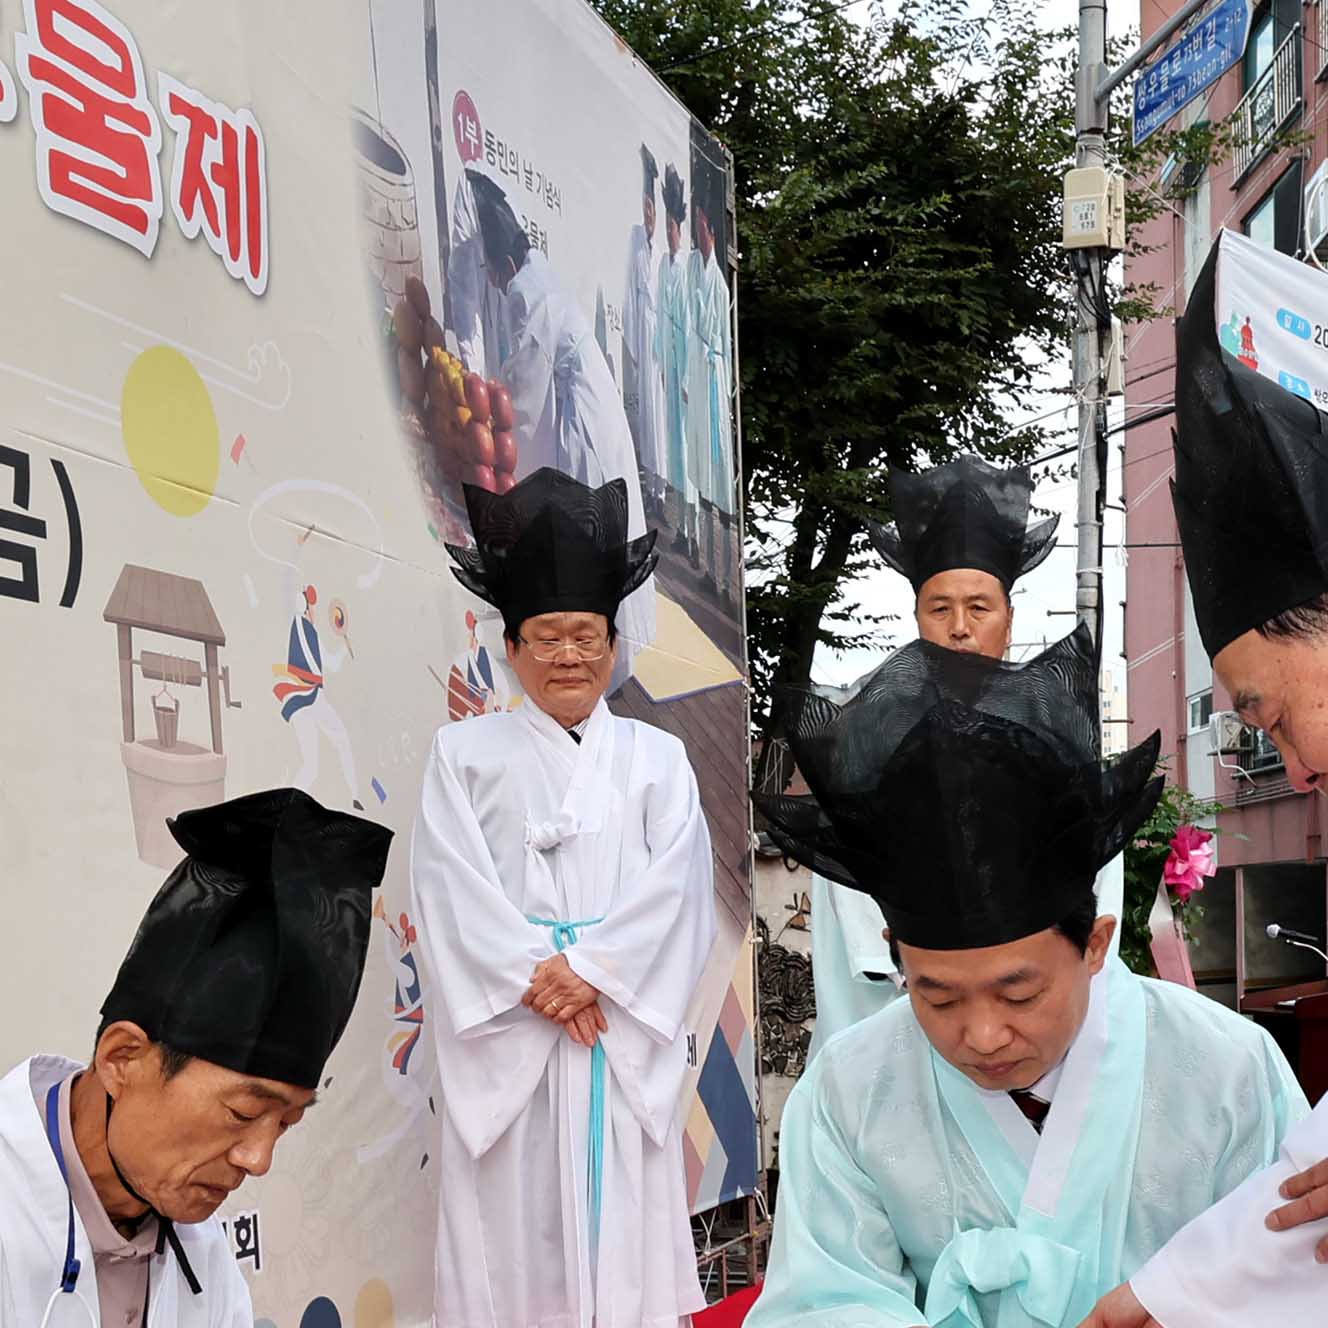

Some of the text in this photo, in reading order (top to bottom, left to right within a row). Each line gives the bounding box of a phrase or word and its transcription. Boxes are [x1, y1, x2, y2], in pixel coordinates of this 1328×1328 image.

[458, 112, 479, 155] 1부
[484, 130, 521, 185] 동민의
[523, 159, 534, 193] 날
